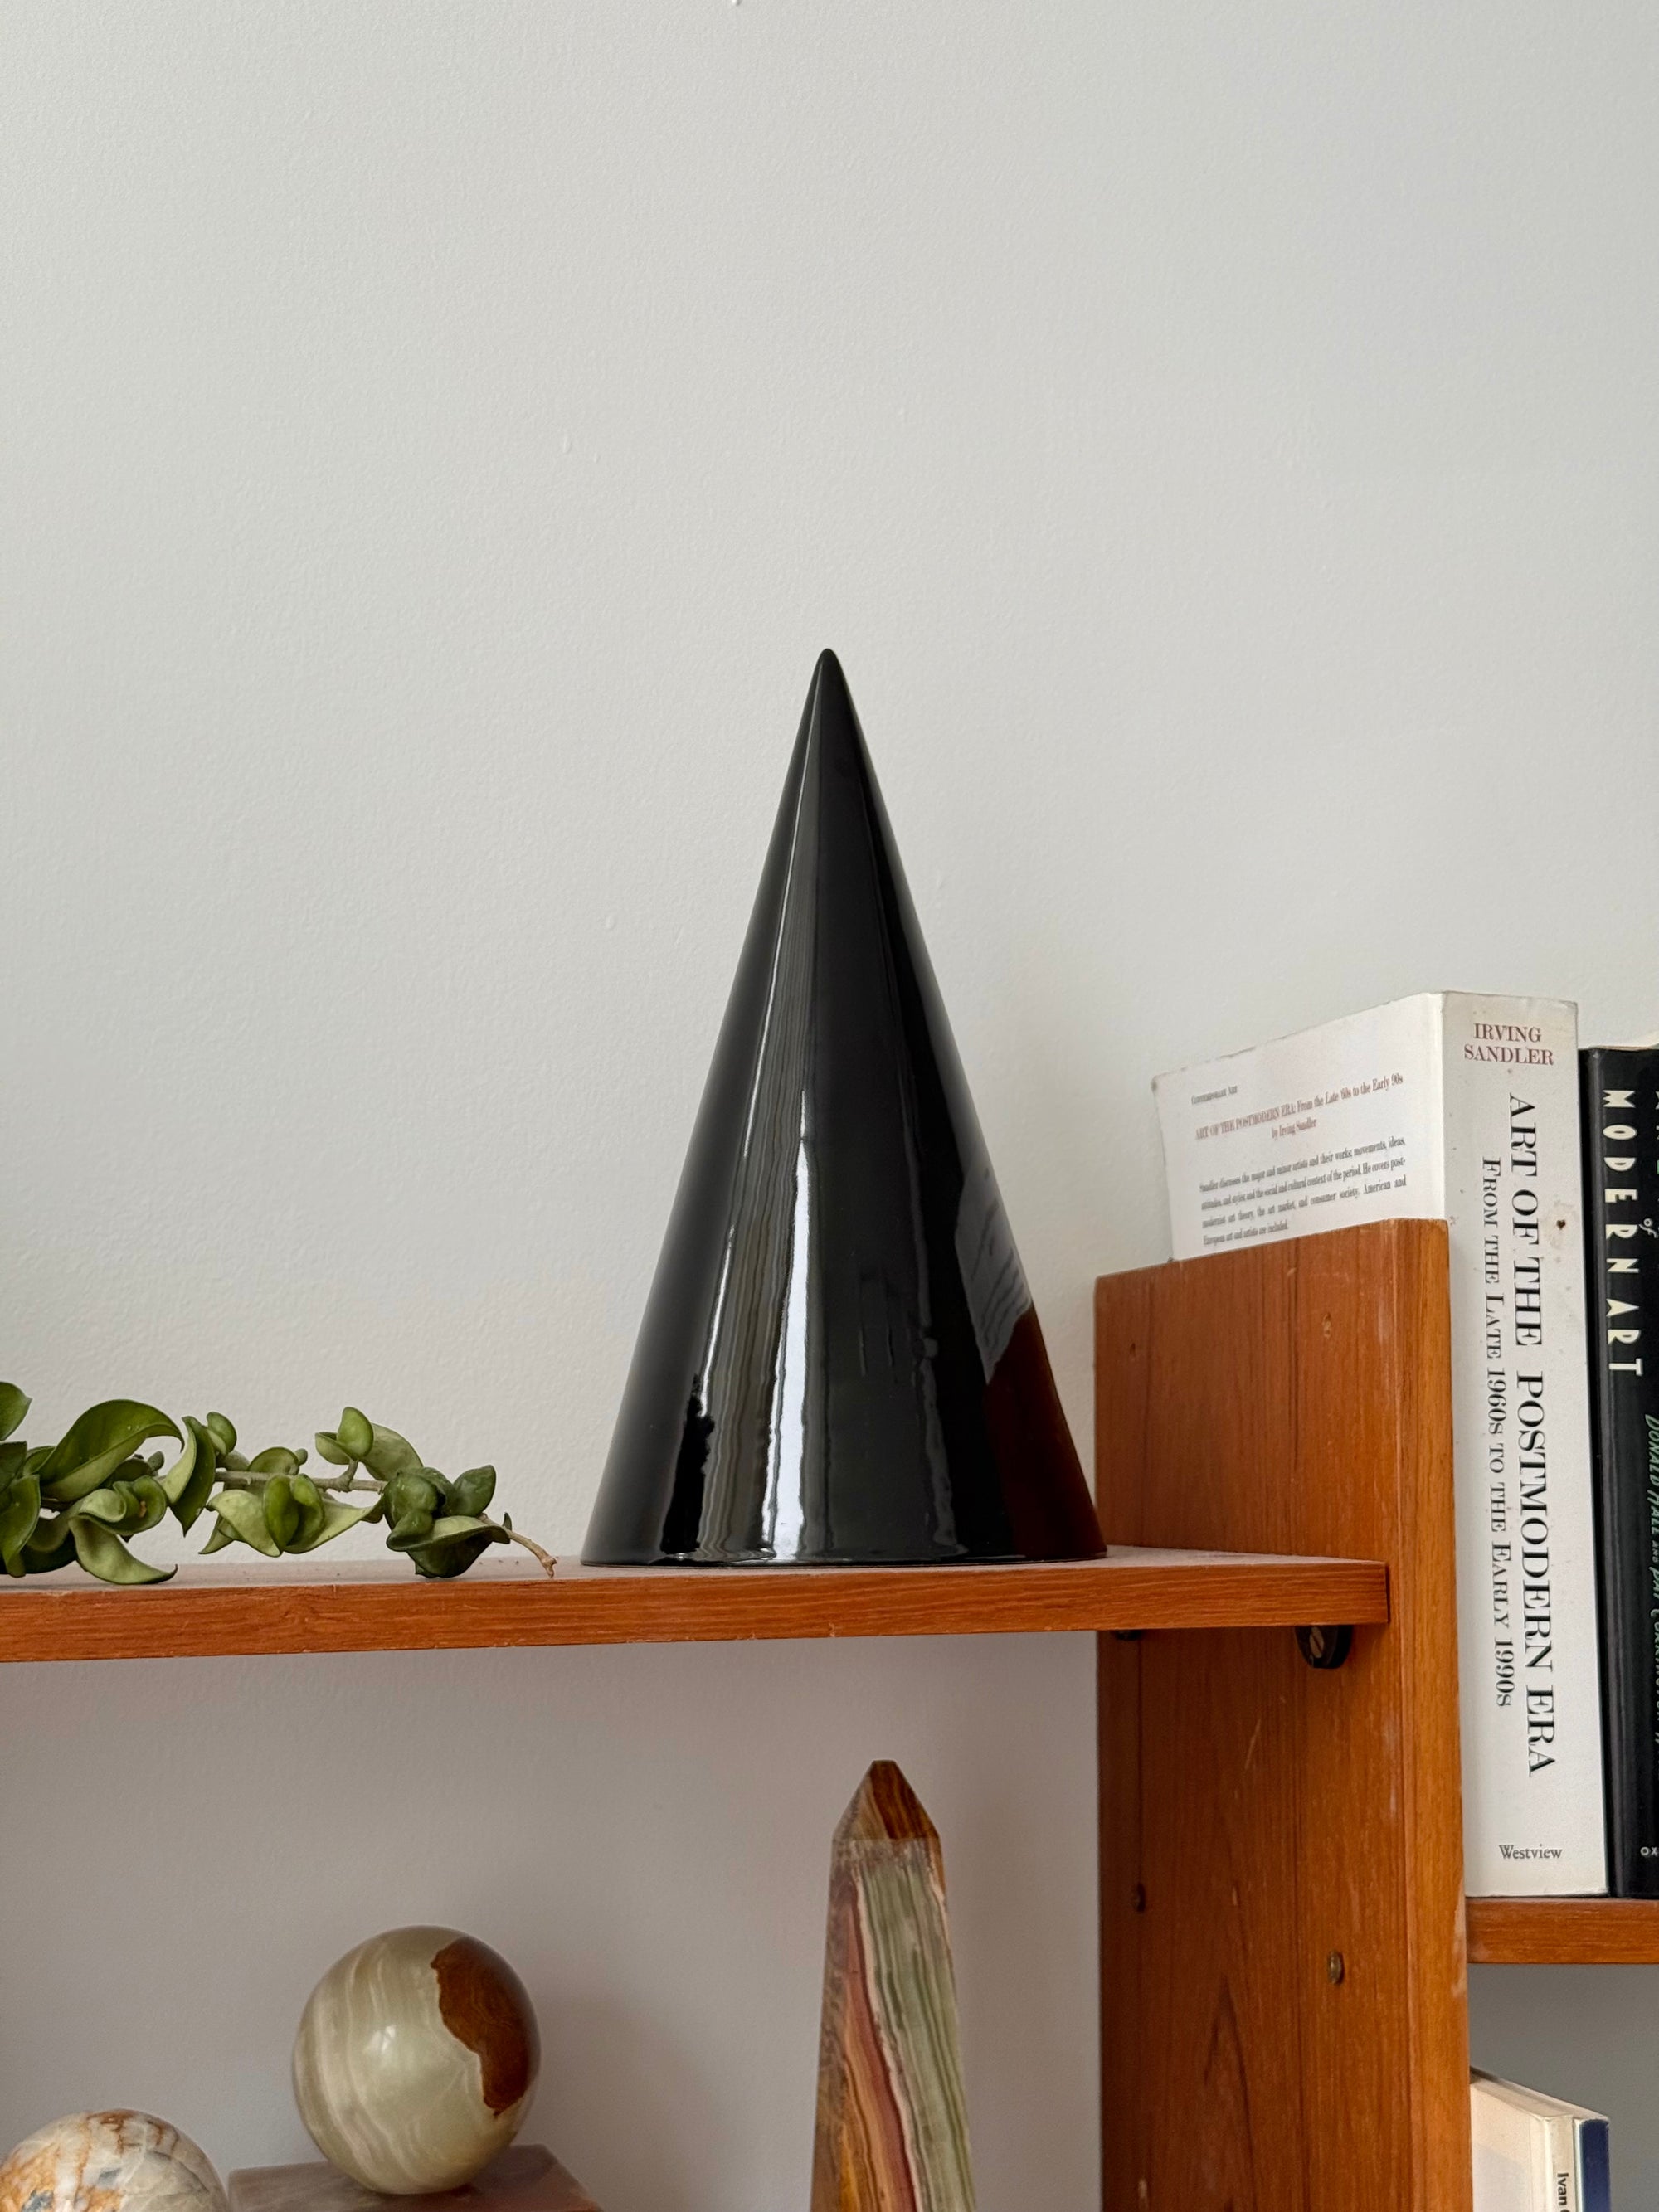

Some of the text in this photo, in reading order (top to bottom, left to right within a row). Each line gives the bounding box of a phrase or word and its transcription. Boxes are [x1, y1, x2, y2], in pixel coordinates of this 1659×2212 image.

[1474, 1023, 1542, 1043] IRVING
[1464, 1044, 1554, 1066] SANDLER
[1297, 1100, 1312, 1112] From
[1314, 1094, 1323, 1107] the
[1325, 1091, 1339, 1105] Late
[1352, 1086, 1360, 1096] to
[1360, 1081, 1370, 1094] the
[1372, 1075, 1390, 1091] Early
[1309, 1155, 1318, 1167] and
[1320, 1150, 1333, 1164] their
[1326, 1170, 1332, 1182] of
[1333, 1169, 1342, 1180] the
[1362, 1162, 1371, 1174] He
[1372, 1160, 1389, 1172] covers
[1390, 1157, 1405, 1171] post-
[1363, 1179, 1391, 1194] American
[1394, 1174, 1407, 1188] and
[1603, 1090, 1643, 1377] MODERN ART
[1638, 1218, 1658, 1238] of
[1510, 1092, 1556, 1777] ART OF THE POSTMODERN ERA
[1498, 1843, 1563, 1860] Westview
[1557, 2172, 1569, 2206] Ivan
